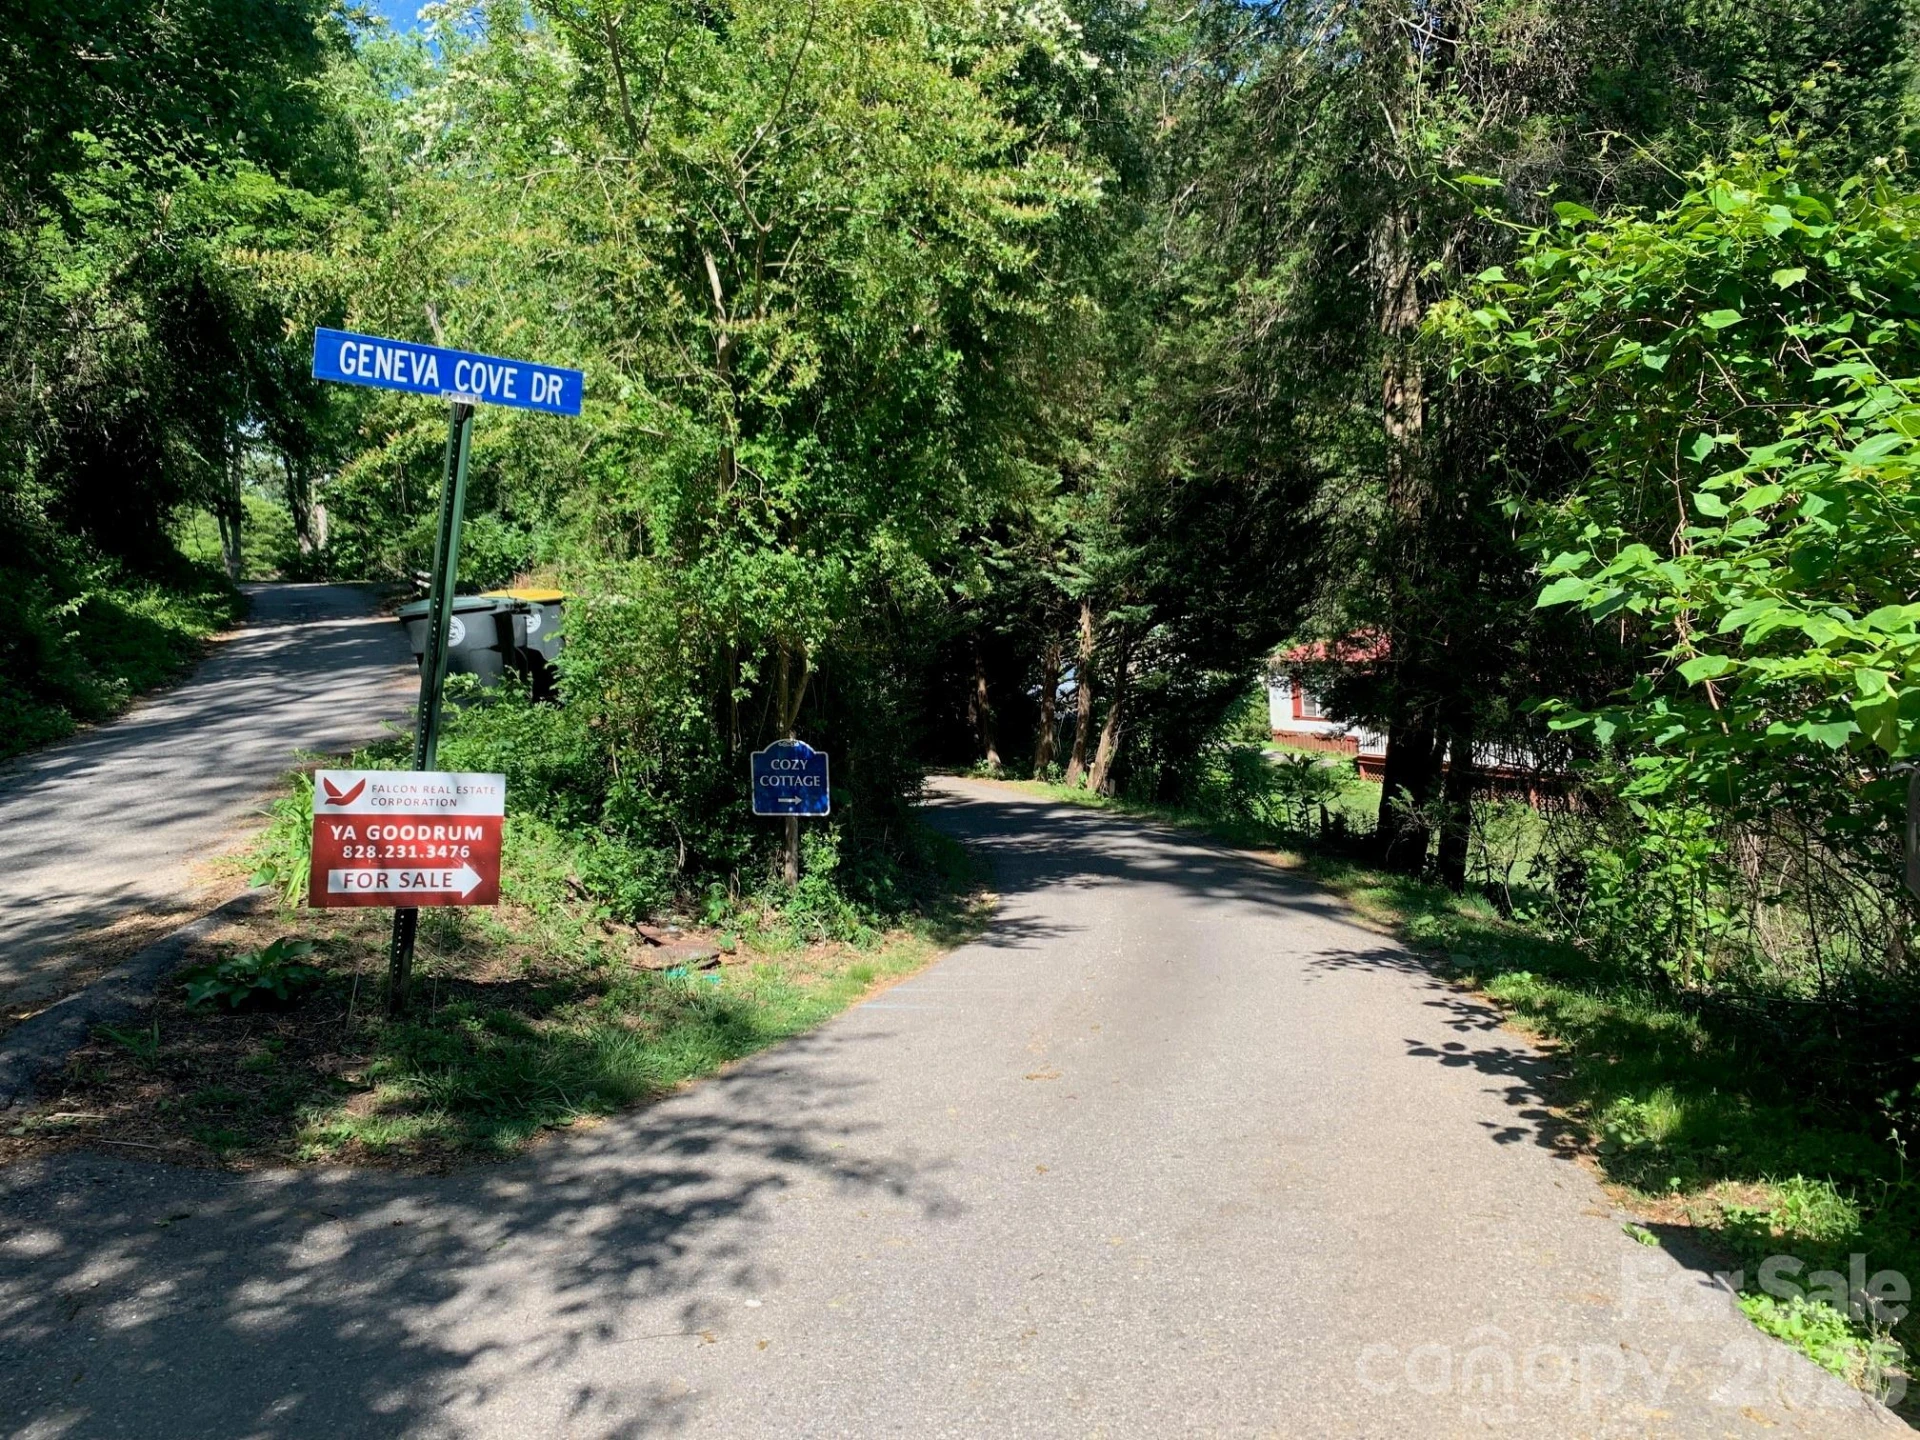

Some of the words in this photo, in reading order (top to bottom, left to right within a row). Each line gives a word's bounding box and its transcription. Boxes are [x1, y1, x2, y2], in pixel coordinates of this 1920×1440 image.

[339, 341, 439, 387] GENEVA
[454, 360, 517, 399] COVE
[531, 372, 563, 405] DR
[770, 759, 808, 770] COZY
[760, 775, 820, 787] COTTAGE
[371, 784, 418, 794] FALCON
[423, 785, 451, 794] REAL
[456, 785, 496, 795] ESTATE
[371, 797, 457, 807] CORPORATION
[331, 825, 357, 841] YA
[366, 825, 483, 841] GOODRUM
[343, 845, 470, 859] 828.231.3476
[343, 872, 389, 889] FOR
[399, 872, 453, 888] SALE
